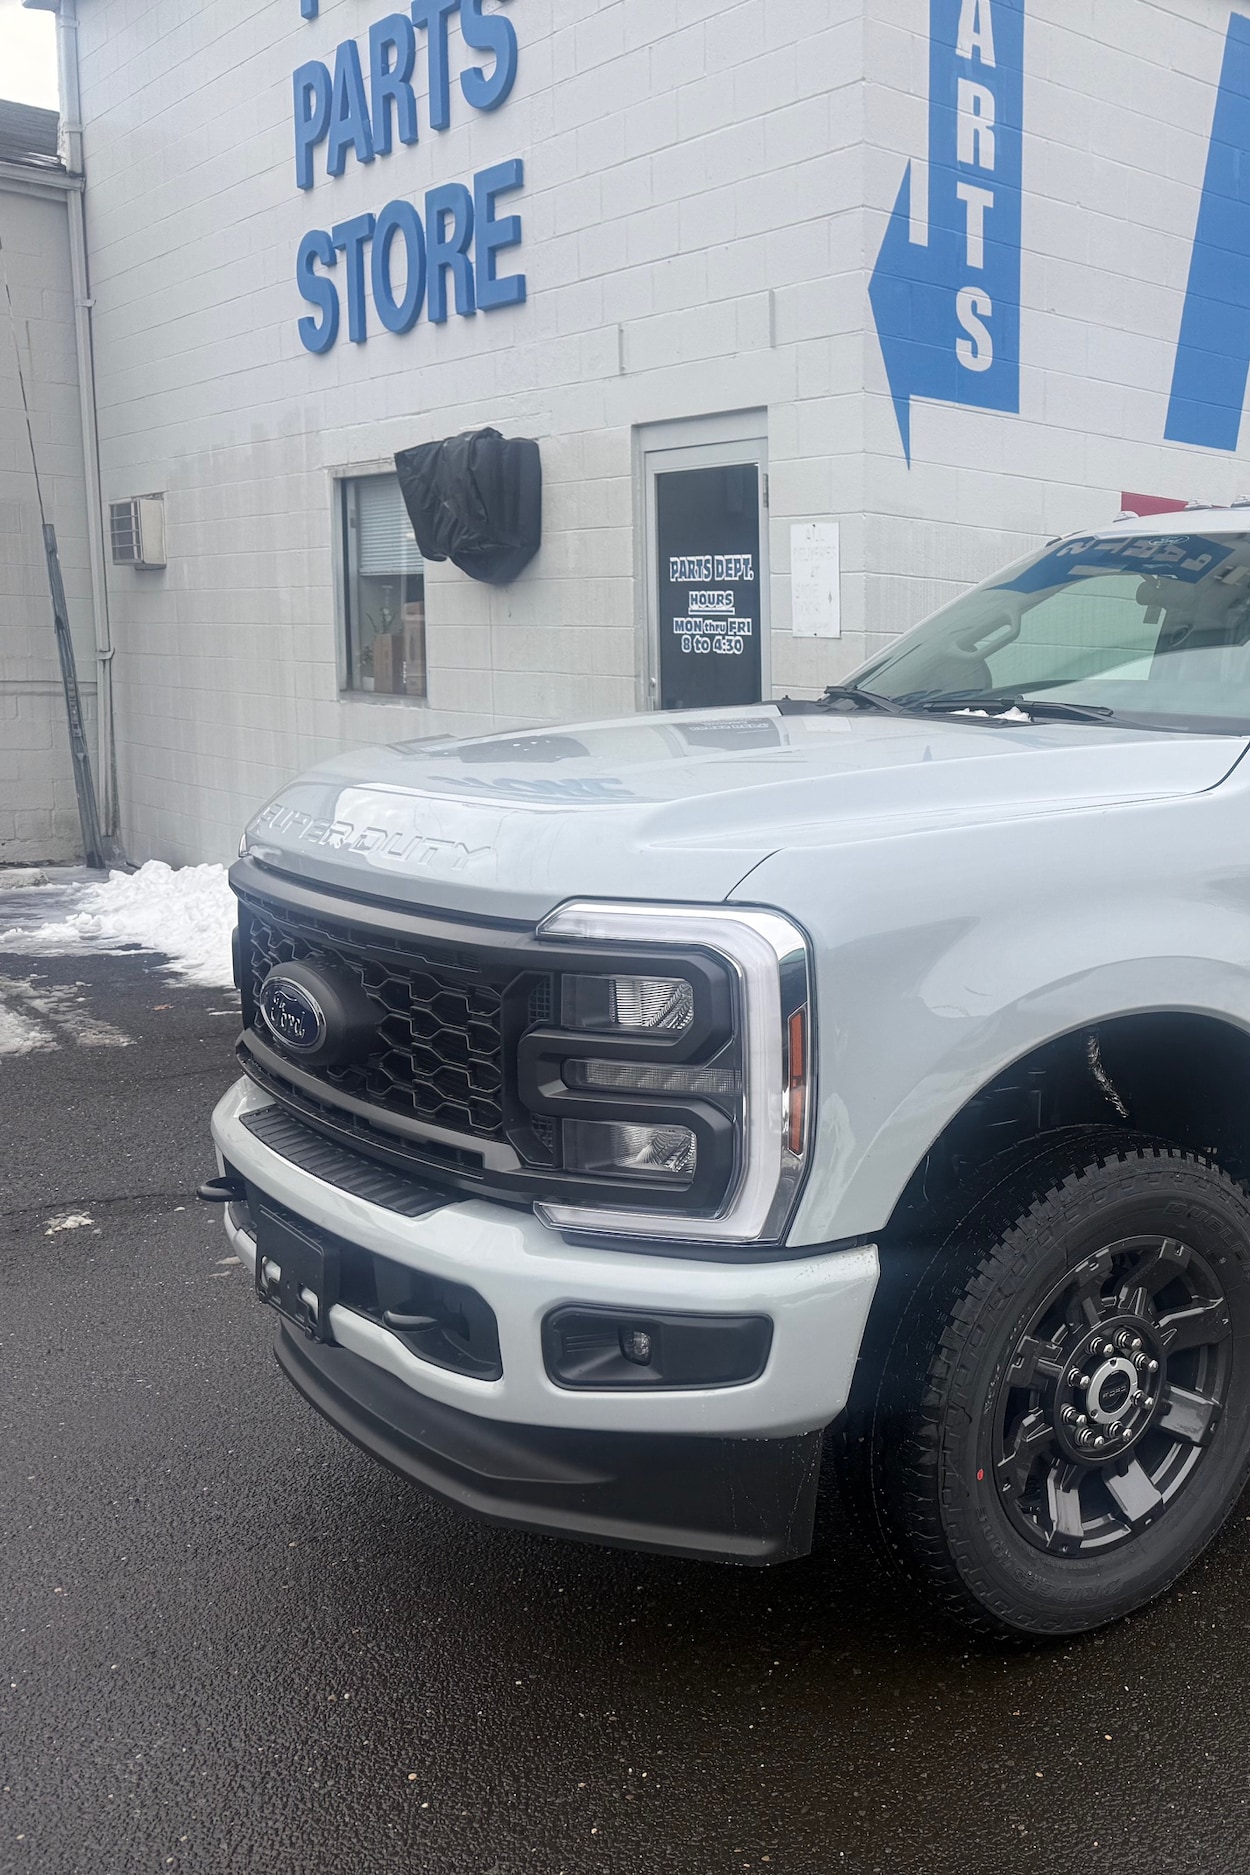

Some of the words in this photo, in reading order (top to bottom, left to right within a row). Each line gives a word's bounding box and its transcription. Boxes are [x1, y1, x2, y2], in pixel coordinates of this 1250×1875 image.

[293, 0, 518, 190] PARTS
[297, 158, 526, 353] STORE
[669, 555, 712, 582] PARTS
[714, 554, 755, 581] DEPT.
[688, 590, 734, 609] HOURS
[673, 617, 703, 634] MON
[727, 617, 752, 635] FRI
[681, 634, 692, 653] 8
[693, 634, 711, 653] to
[712, 635, 744, 654] 4:30
[255, 803, 354, 849] SUPER
[349, 826, 492, 871] DUTY
[270, 990, 306, 1040] Ford
